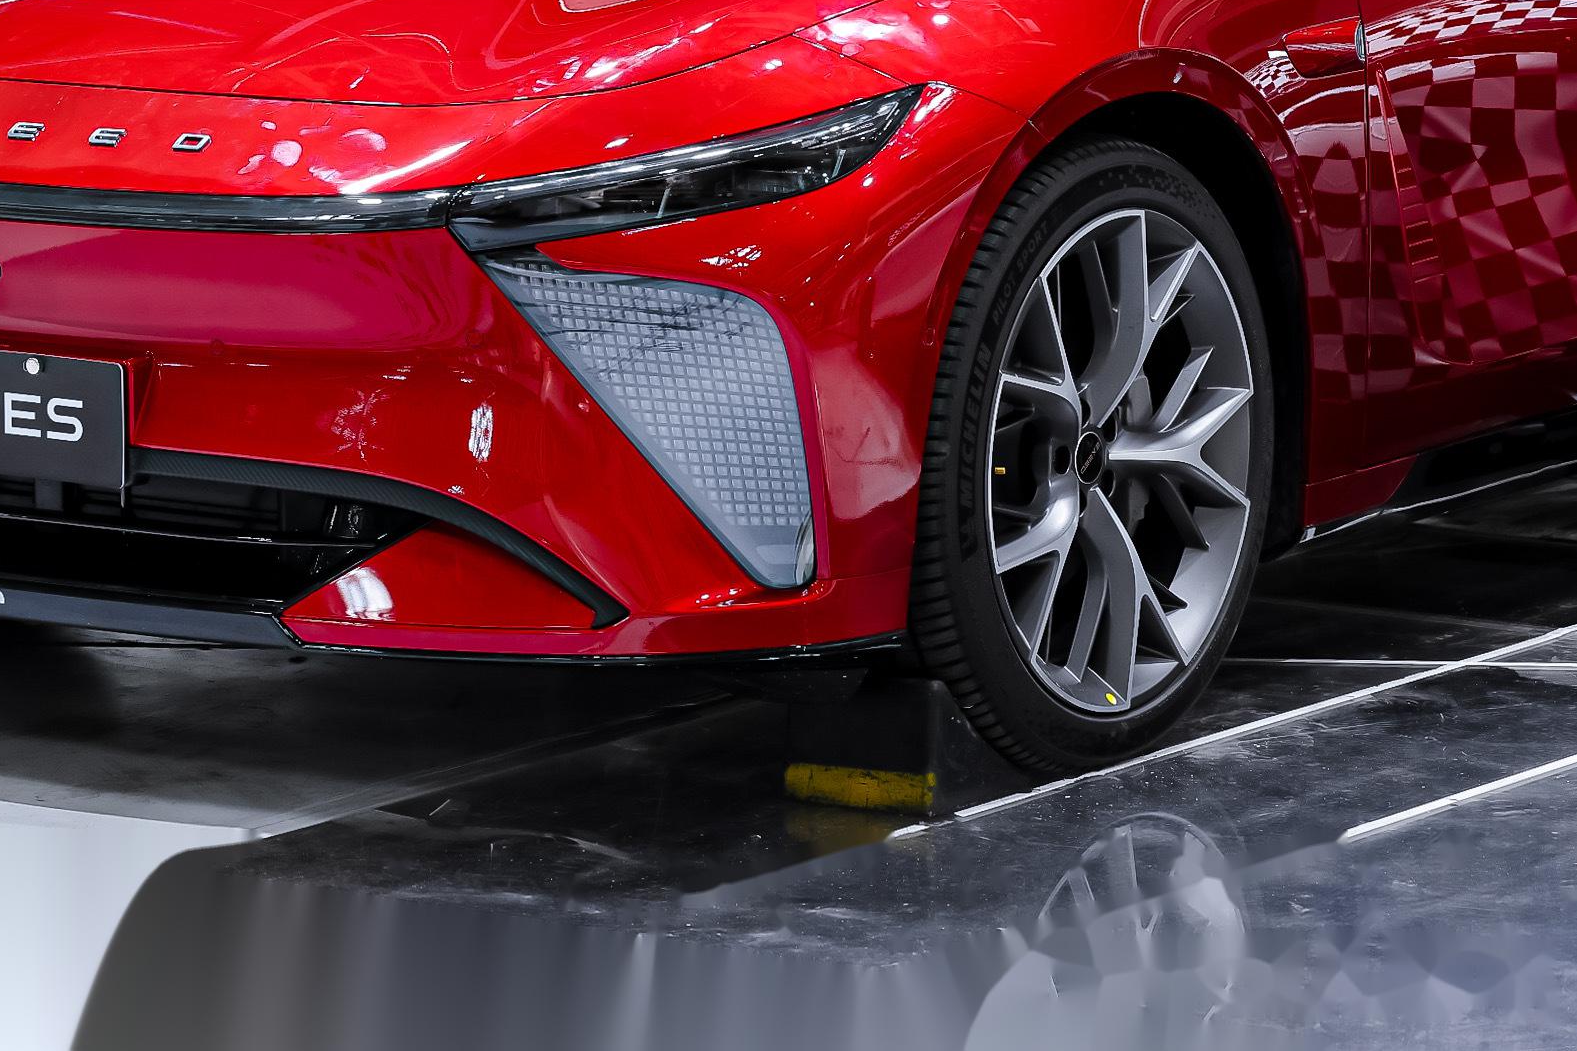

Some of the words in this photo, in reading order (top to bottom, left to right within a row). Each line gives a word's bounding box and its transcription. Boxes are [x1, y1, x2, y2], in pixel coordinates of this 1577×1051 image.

[3, 391, 85, 442] ES
[959, 342, 992, 509] MICHELIN
[992, 270, 1016, 325] PILOT
[1016, 220, 1048, 272] SPORT
